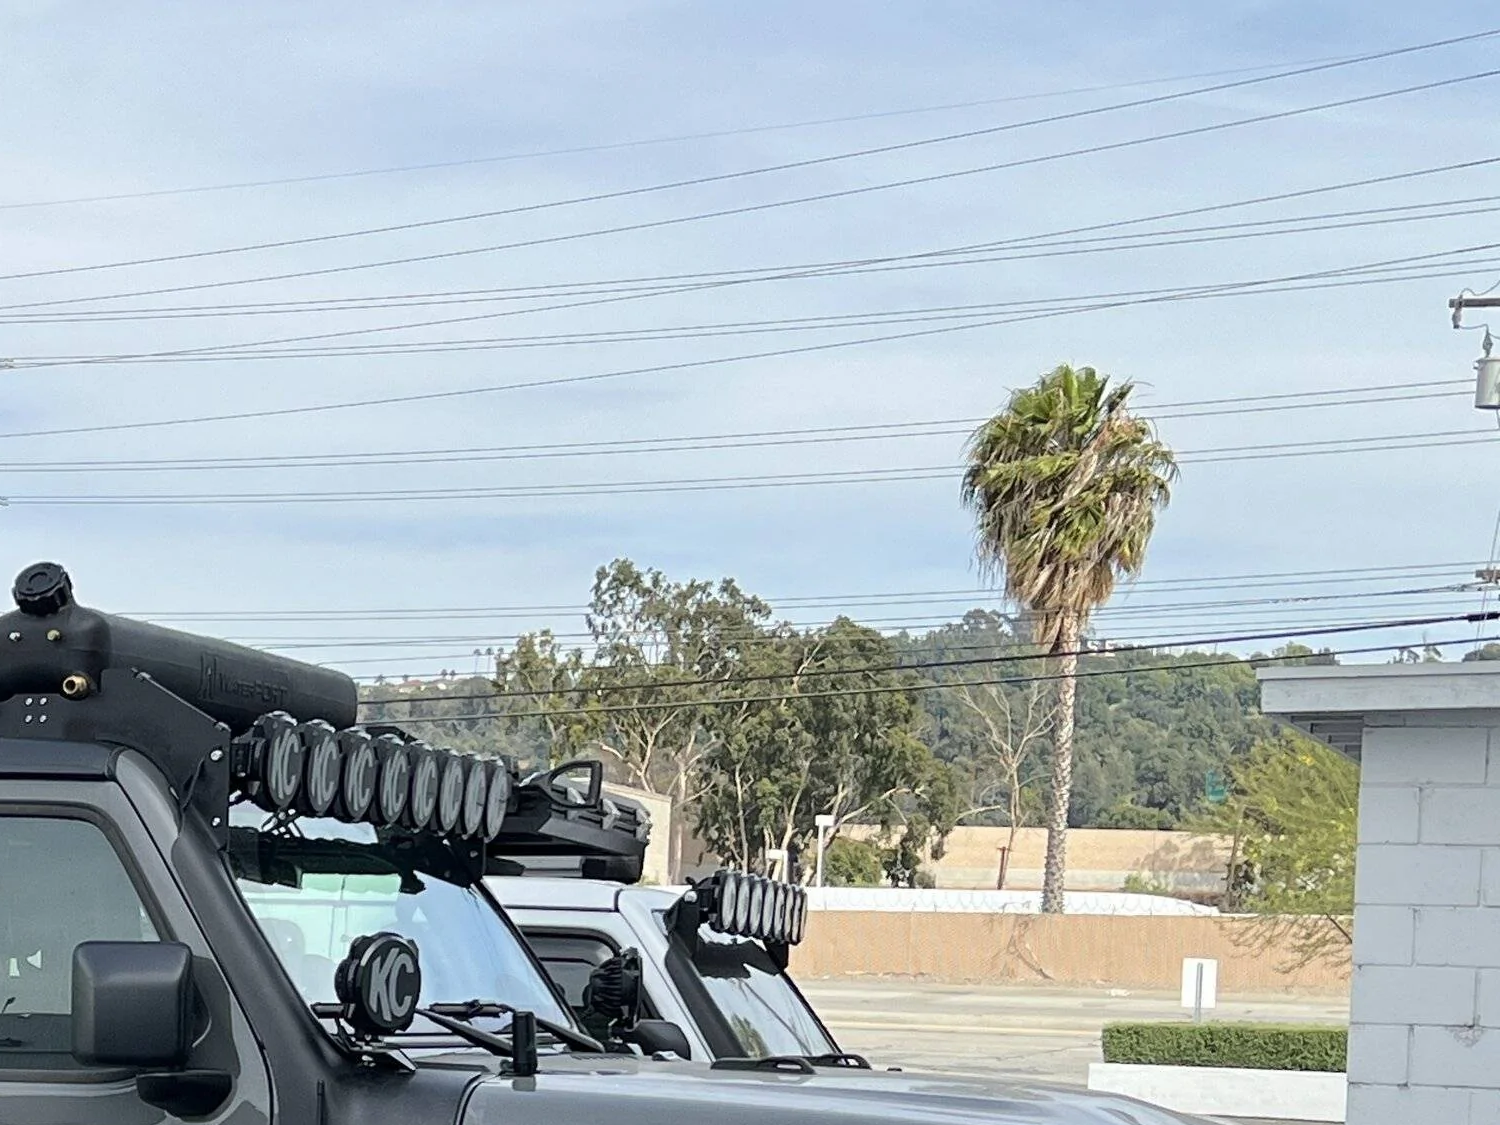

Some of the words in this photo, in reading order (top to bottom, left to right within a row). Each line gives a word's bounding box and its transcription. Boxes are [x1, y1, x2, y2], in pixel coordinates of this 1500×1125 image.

[271, 728, 299, 800] KC
[311, 735, 337, 806] KC
[348, 743, 373, 812] KC
[383, 750, 406, 817] KC
[369, 947, 415, 1022] KC
